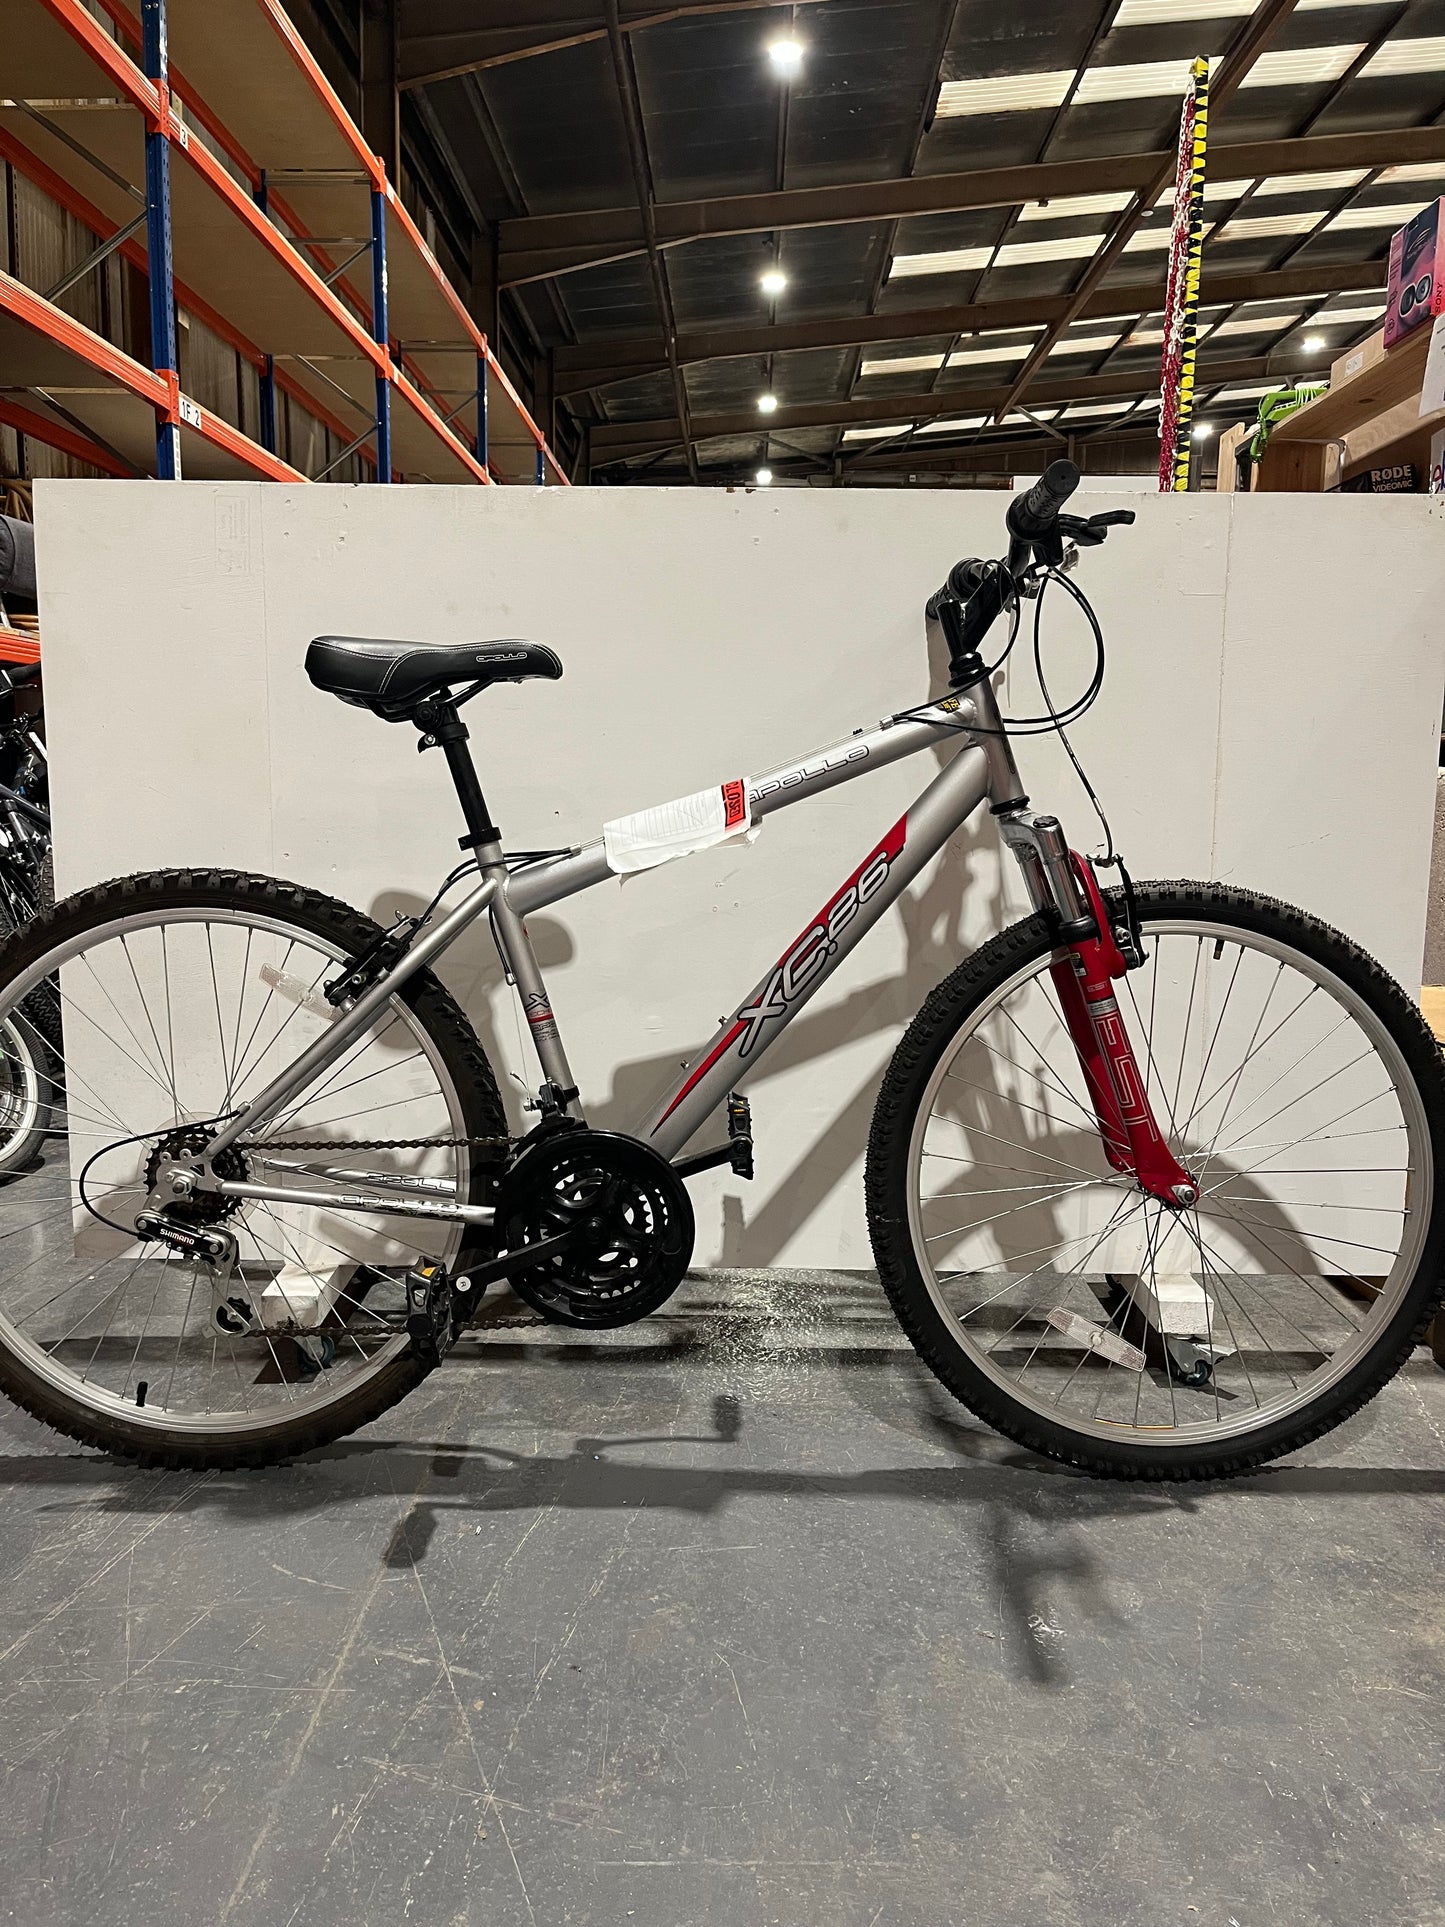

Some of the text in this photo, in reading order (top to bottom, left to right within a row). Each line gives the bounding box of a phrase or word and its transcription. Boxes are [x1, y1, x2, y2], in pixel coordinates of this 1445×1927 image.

[1434, 282, 1444, 313] SONY
[182, 400, 200, 427] 1F 2
[1370, 464, 1412, 482] RØDE
[1372, 479, 1413, 493] VIDEOMIC
[724, 779, 742, 819] CLOSED
[159, 1227, 195, 1246] SHIMANO
